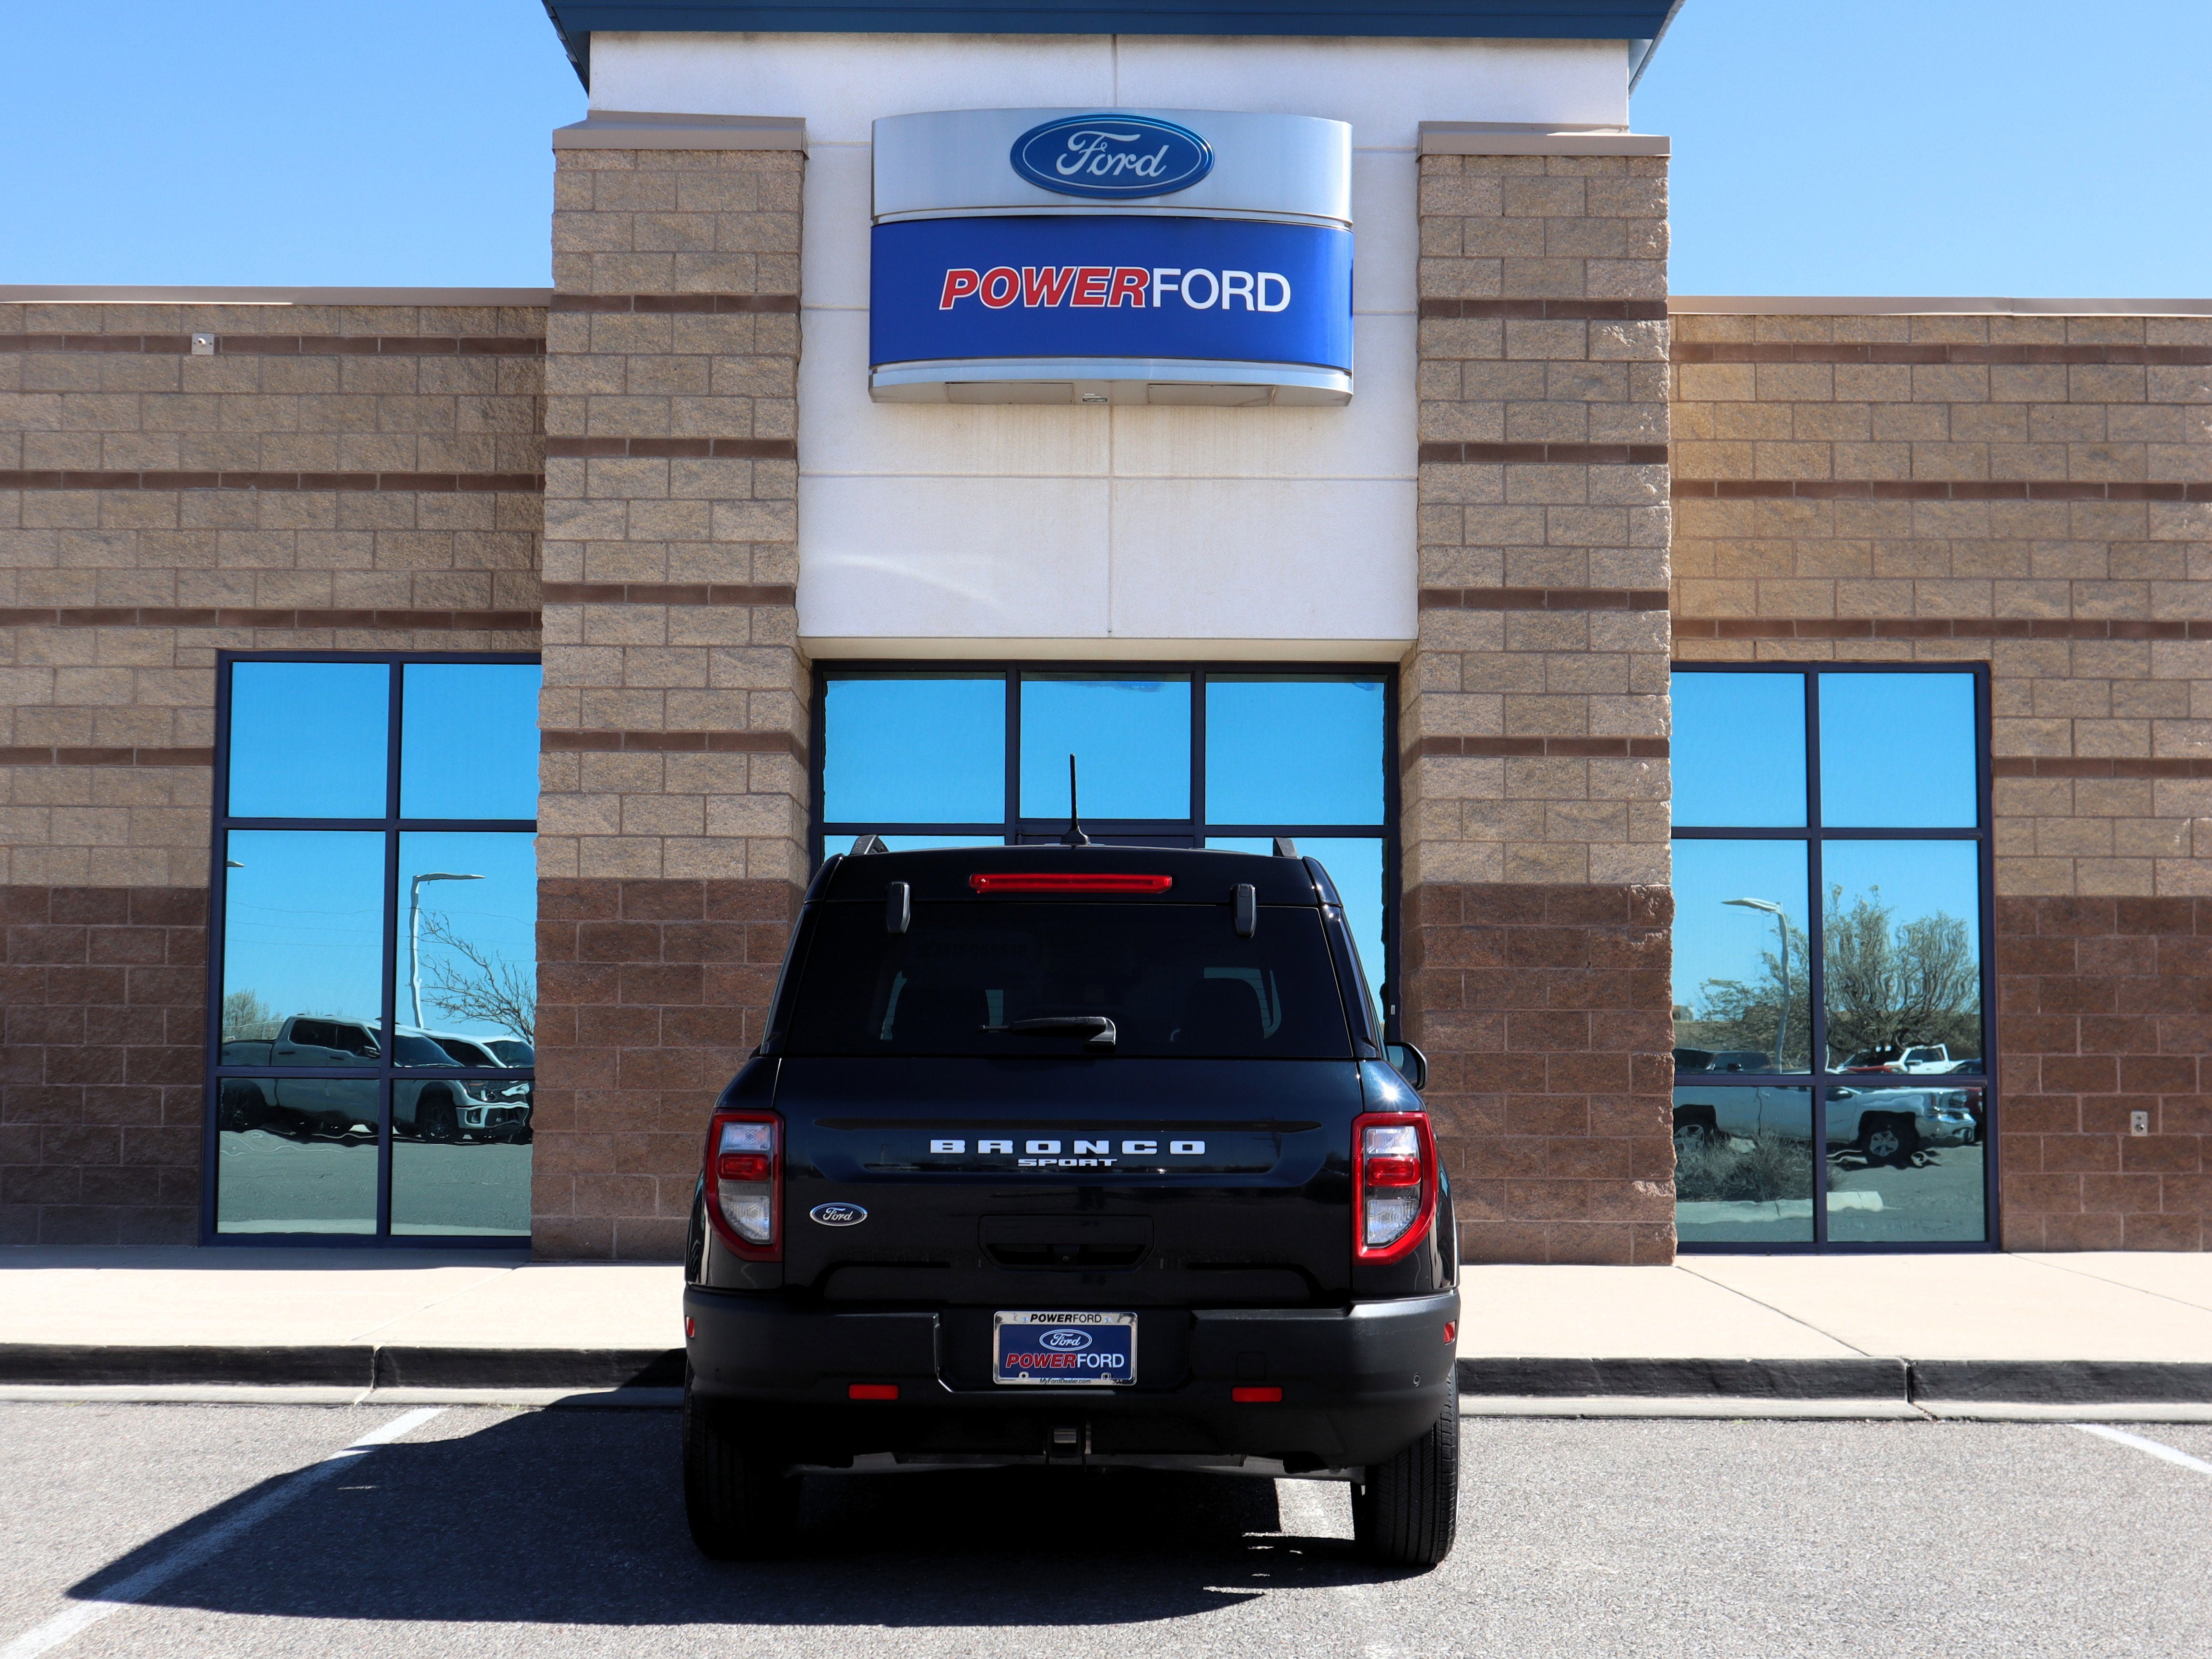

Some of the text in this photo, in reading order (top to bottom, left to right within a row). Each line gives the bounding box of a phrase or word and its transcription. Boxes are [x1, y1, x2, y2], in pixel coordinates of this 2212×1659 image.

[1056, 130, 1169, 178] Ford
[939, 266, 1291, 313] POWERFORD
[930, 1139, 1205, 1154] BRONCO
[822, 1207, 854, 1221] Ford
[1050, 1333, 1081, 1346] Ford
